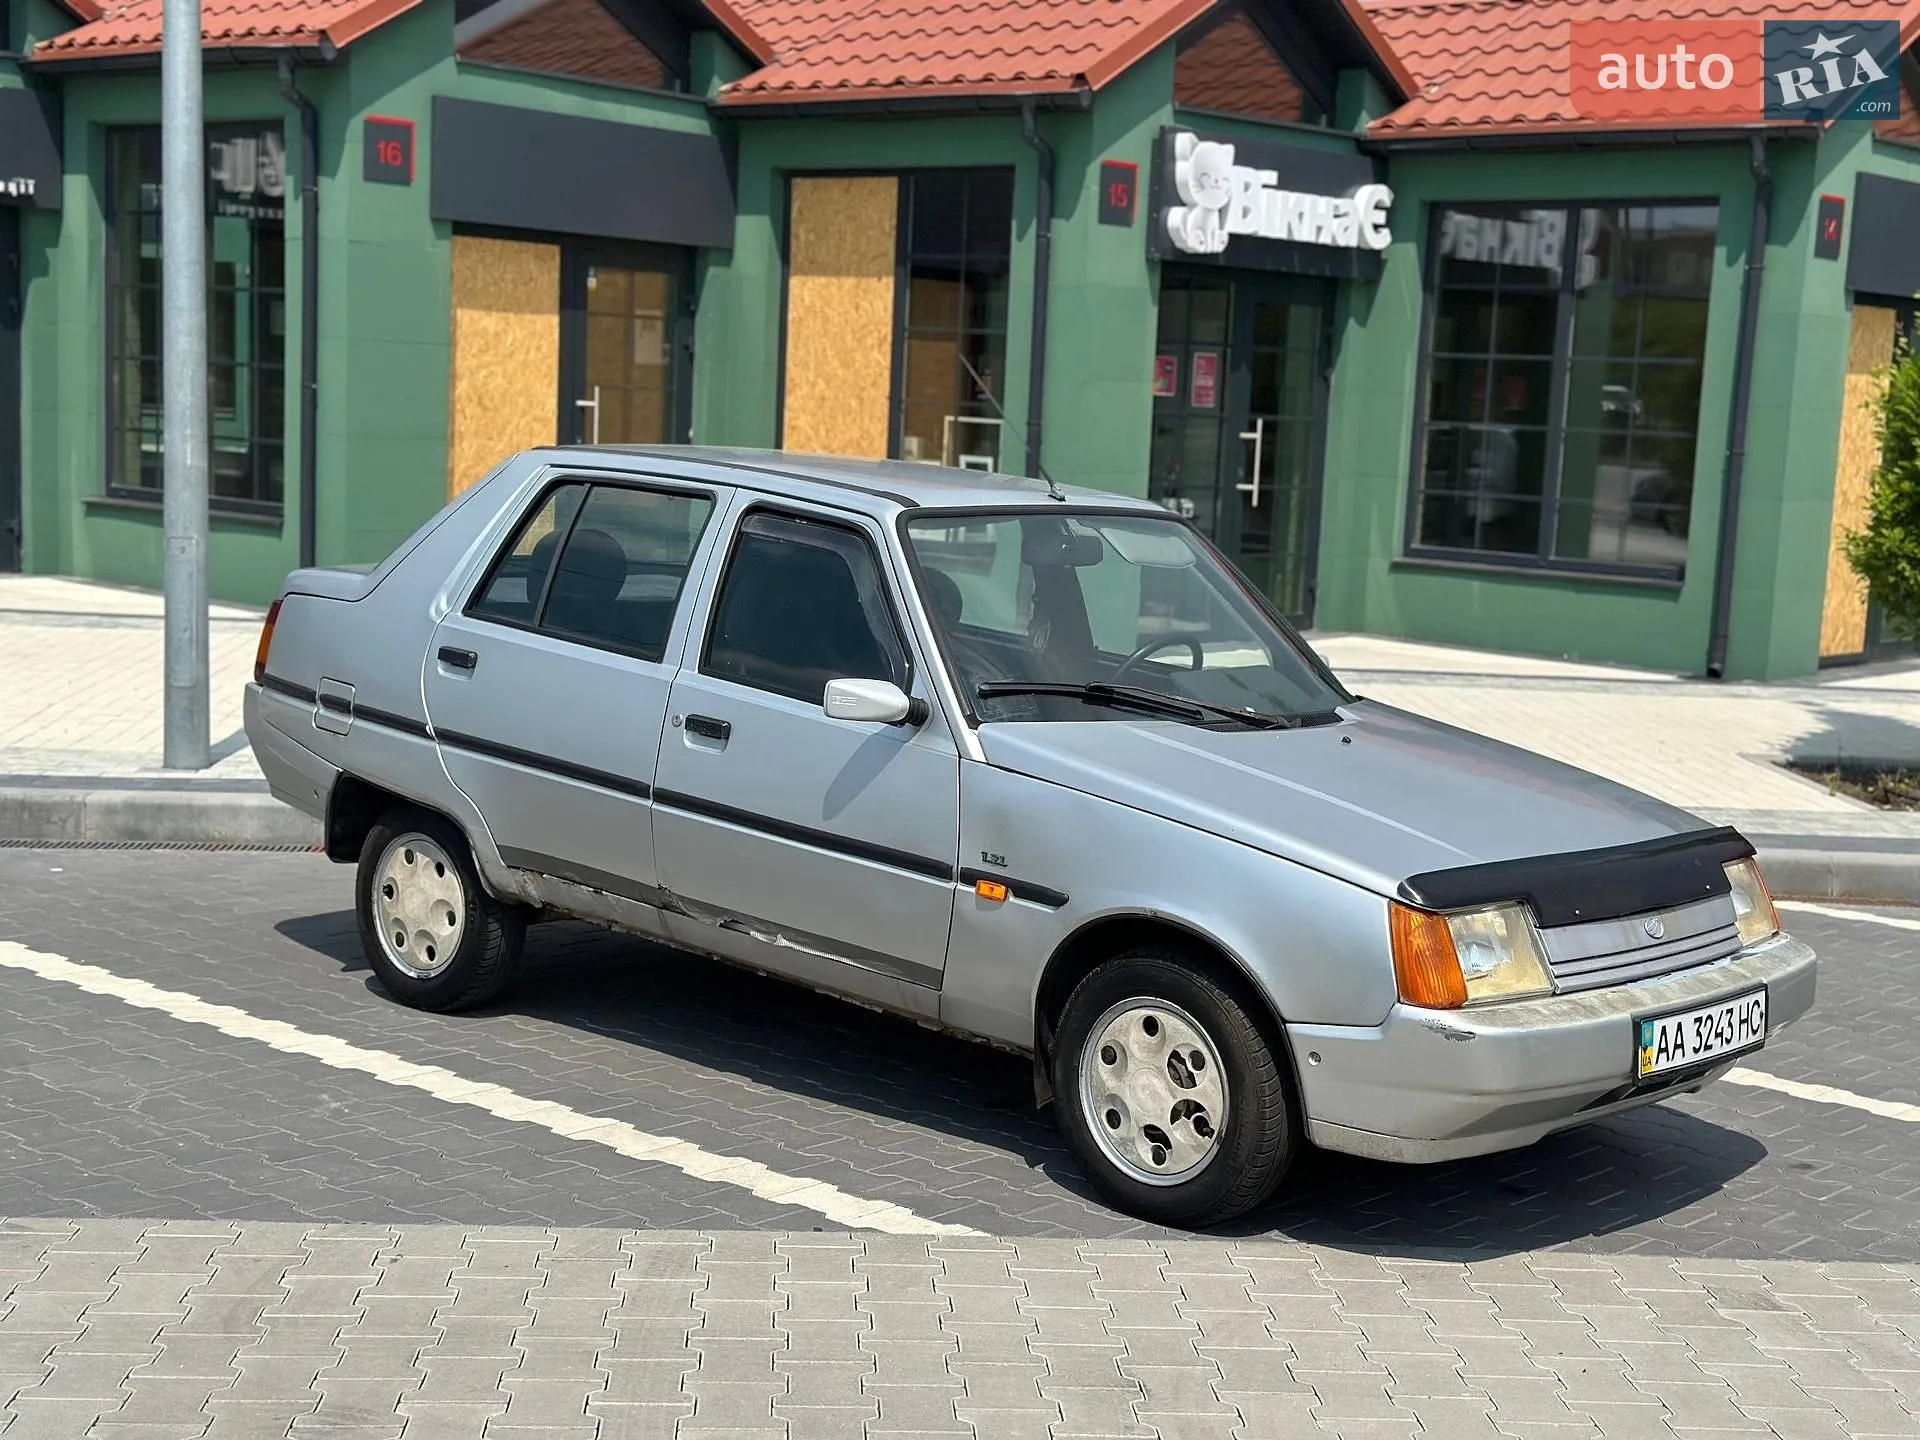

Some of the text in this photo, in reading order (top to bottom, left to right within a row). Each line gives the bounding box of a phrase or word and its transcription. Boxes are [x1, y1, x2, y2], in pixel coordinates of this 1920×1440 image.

[376, 140, 402, 167] 16
[1108, 183, 1128, 208] 15
[1655, 999, 1763, 1064] AA 3243 HC
